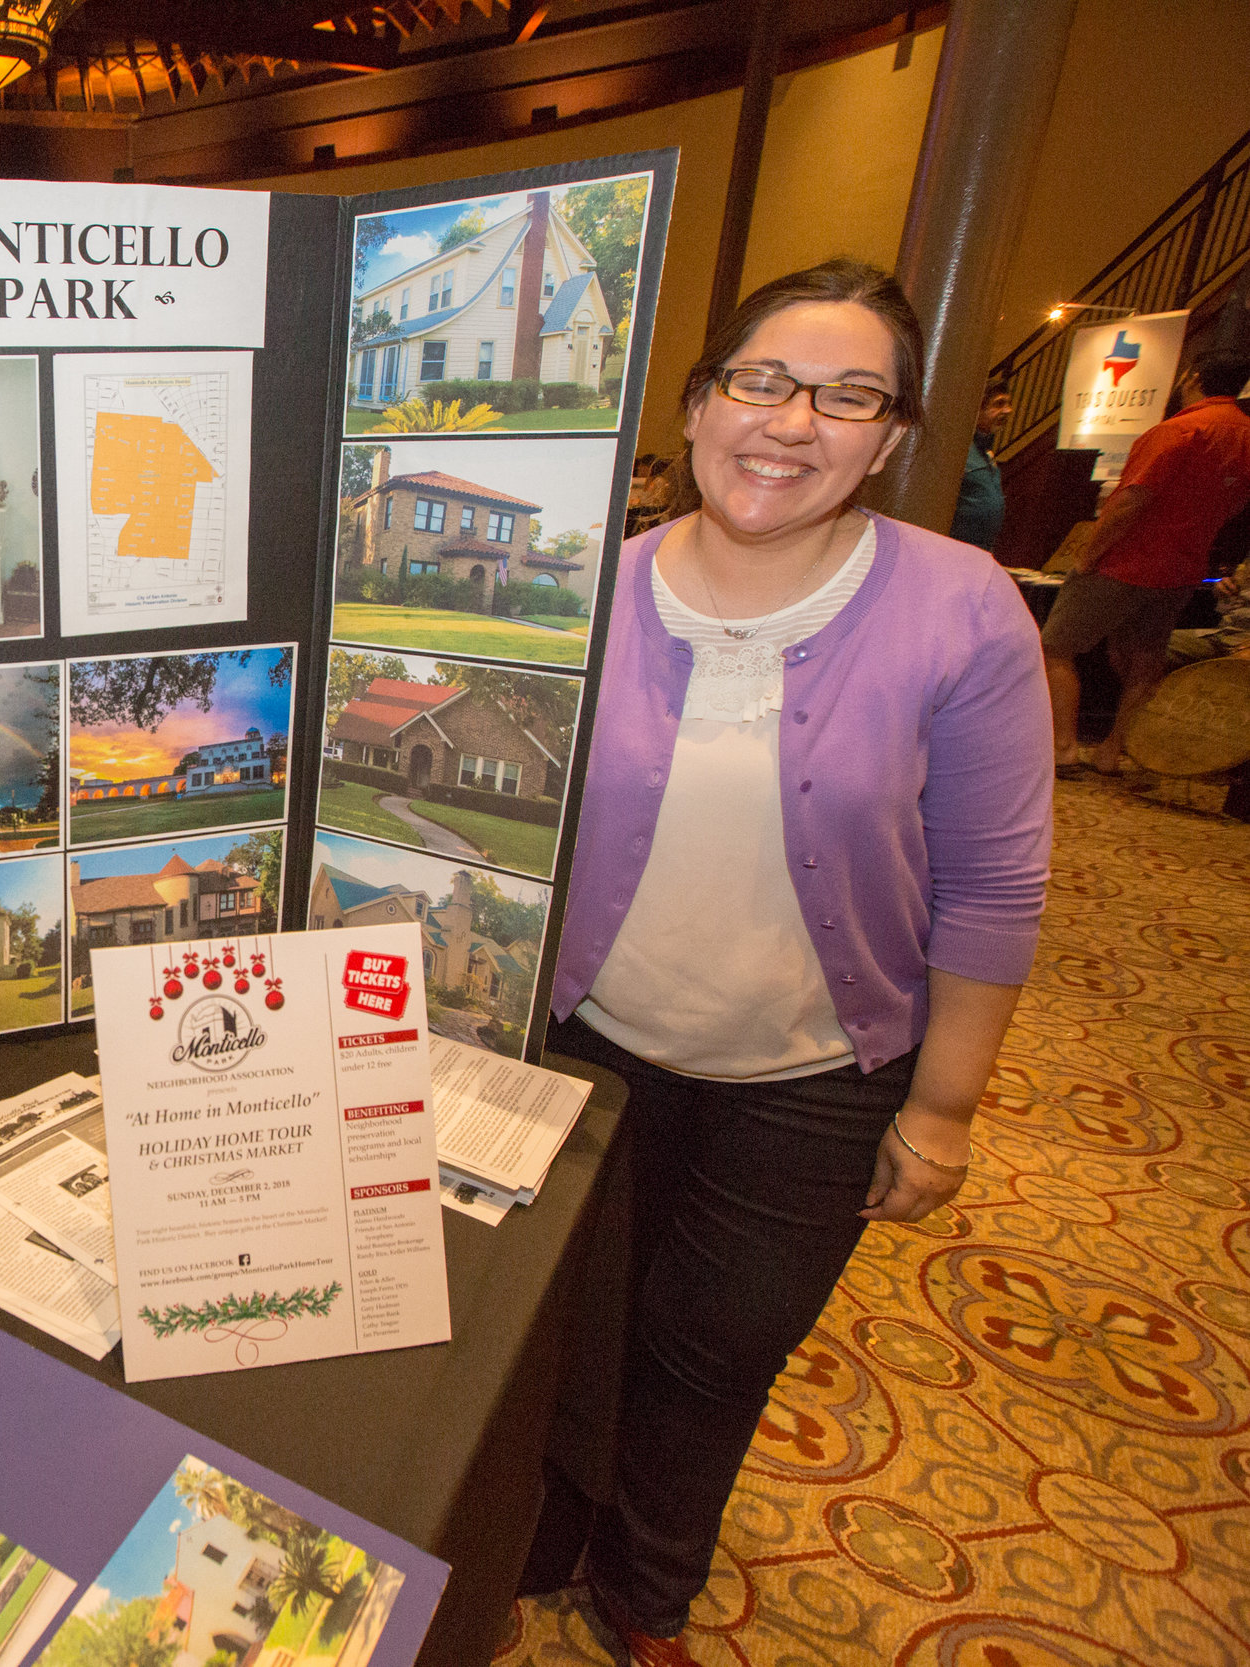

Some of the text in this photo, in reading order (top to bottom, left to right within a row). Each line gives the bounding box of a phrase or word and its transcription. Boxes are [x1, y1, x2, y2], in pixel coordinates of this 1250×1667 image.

[1106, 388, 1158, 408] QUEST
[362, 957, 392, 973] BUY
[348, 970, 401, 989] TICKETS
[357, 992, 393, 1012] HERE
[172, 1027, 265, 1062] Monticello
[342, 1034, 385, 1047] TICKETS
[207, 1055, 234, 1065] PARK
[340, 1050, 354, 1060] $20
[385, 1045, 418, 1056] children
[341, 1059, 392, 1073] under 12 free
[147, 1067, 295, 1090] NEIGHBORHOOD ASSOCIATION
[155, 1109, 202, 1125] Home
[207, 1104, 221, 1118] in
[347, 1103, 410, 1119] BENEFITING
[346, 1117, 402, 1131] Neighborhood
[139, 1124, 313, 1157] HOLIDAY HOME TOUR
[347, 1130, 395, 1143] preservation
[348, 1136, 422, 1154] programs and local
[149, 1142, 304, 1171] & CHRISTMAS MARKET
[349, 1152, 397, 1163] scholarships
[167, 1180, 291, 1202] SUNDAY, DECEMBER 2, 2018
[353, 1182, 409, 1198] SPONSORS
[200, 1200, 209, 1208] 11
[210, 1197, 226, 1207] AM
[246, 1193, 261, 1202] PM
[353, 1206, 387, 1217] PLATINUM
[139, 1267, 160, 1278] FIND
[161, 1266, 173, 1275] US
[174, 1264, 187, 1273] ON
[190, 1258, 235, 1271] FACEBOOK
[358, 1269, 378, 1278] GOLD
